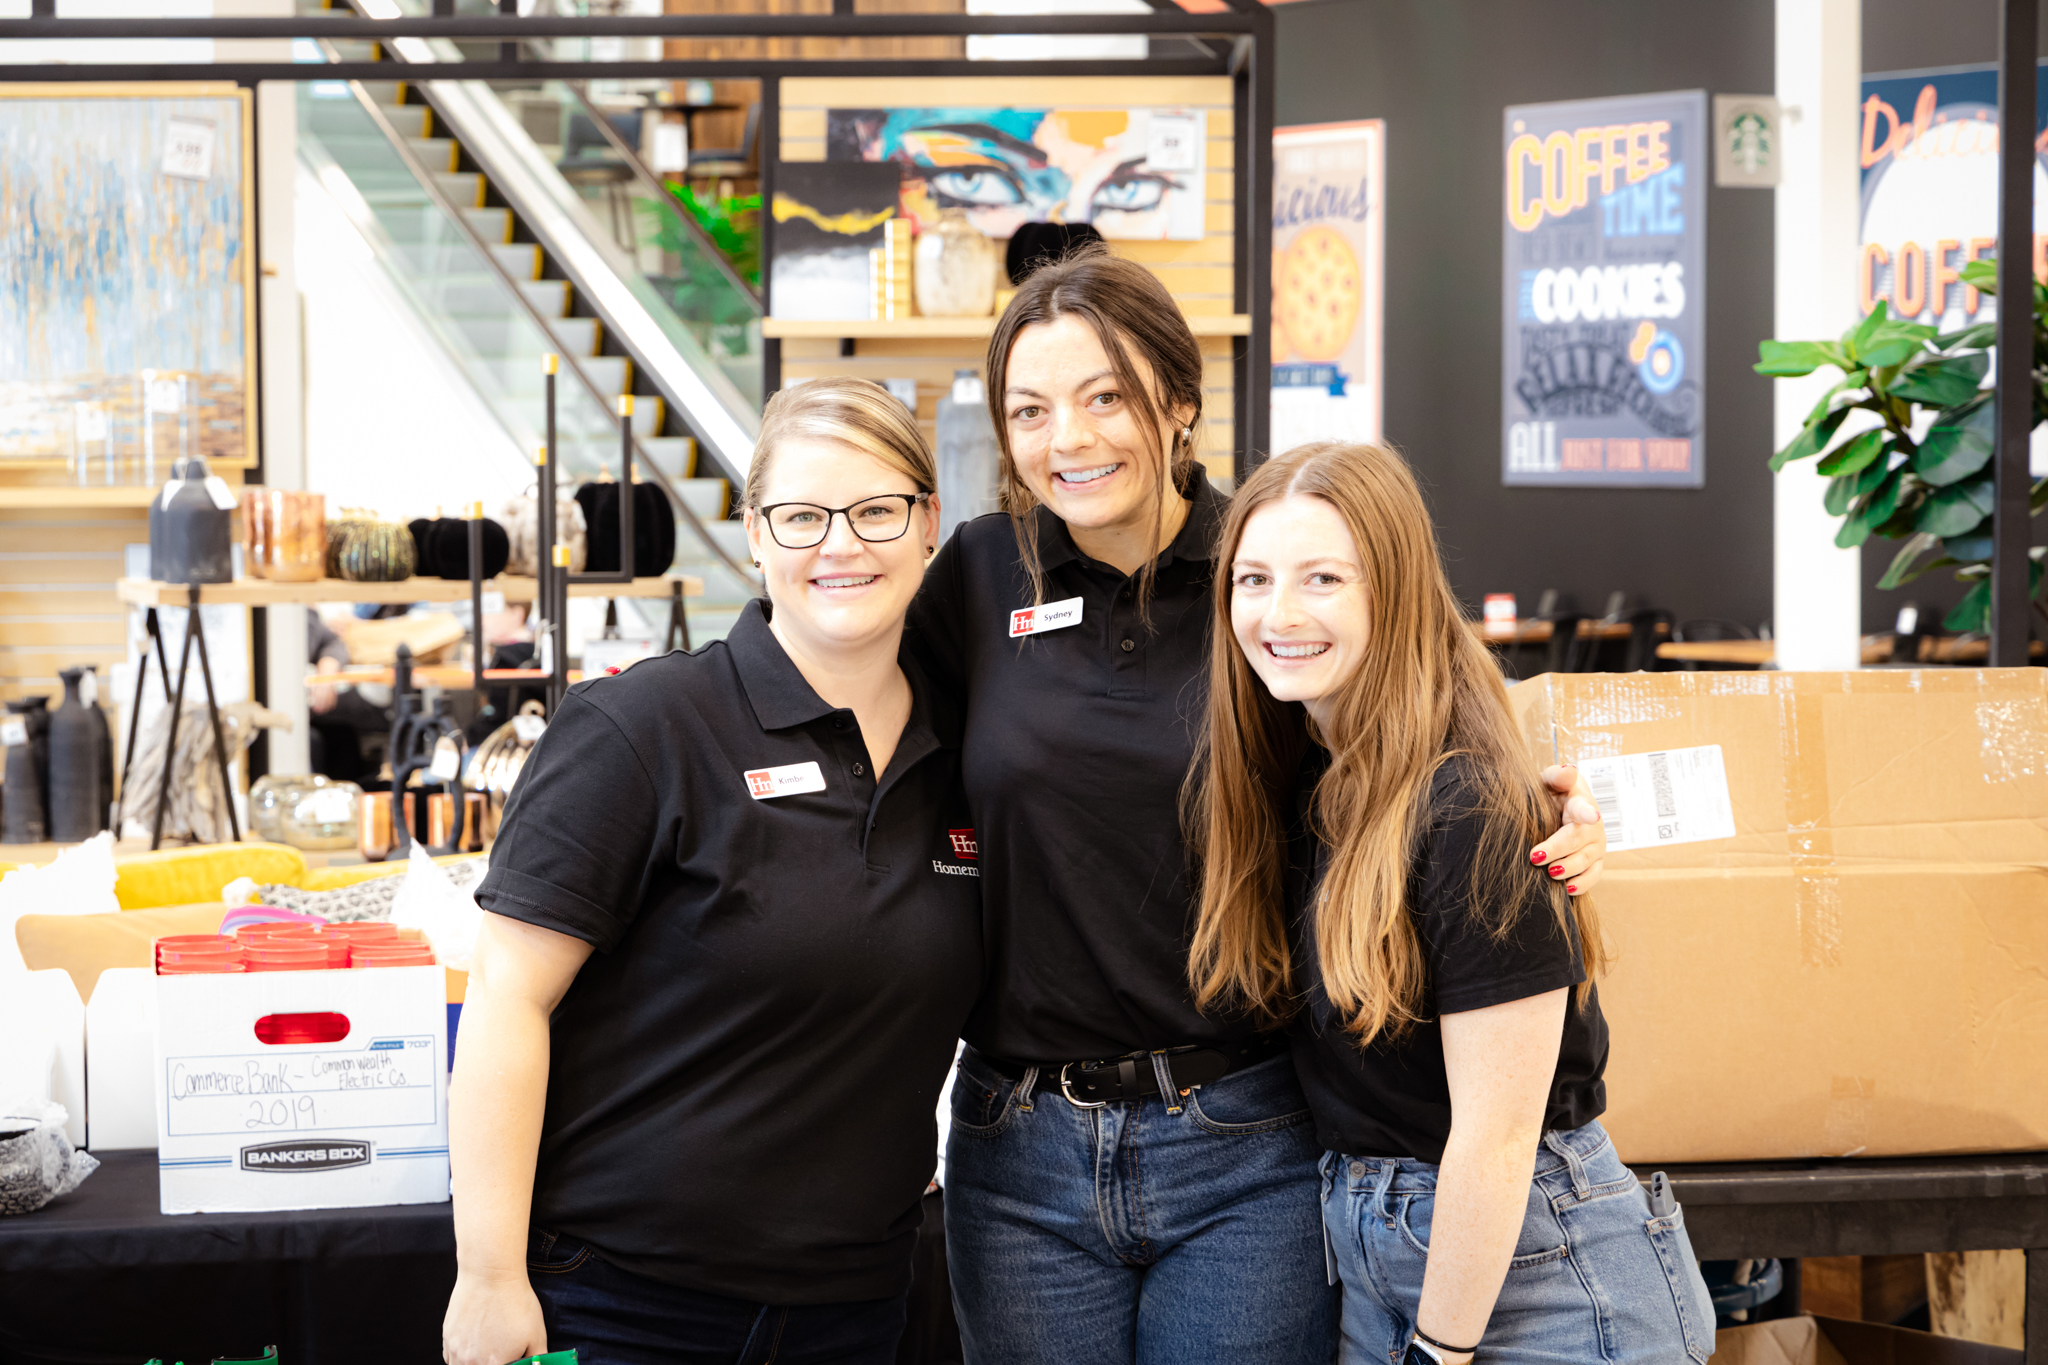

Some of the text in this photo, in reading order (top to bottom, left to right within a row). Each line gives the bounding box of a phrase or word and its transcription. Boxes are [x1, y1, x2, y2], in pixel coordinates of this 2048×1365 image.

[1507, 121, 1671, 232] COFFEE
[1272, 174, 1371, 230] icious
[1600, 161, 1686, 238] TIME
[1532, 261, 1686, 324] COOKIES
[1044, 610, 1073, 622] Sydney
[949, 834, 978, 853] Hm
[173, 1062, 245, 1101] Commerce
[245, 1060, 294, 1094] Bank
[339, 1071, 383, 1090] Electric
[245, 1095, 316, 1130] 2019
[247, 1147, 365, 1164] BANKERS BOX
